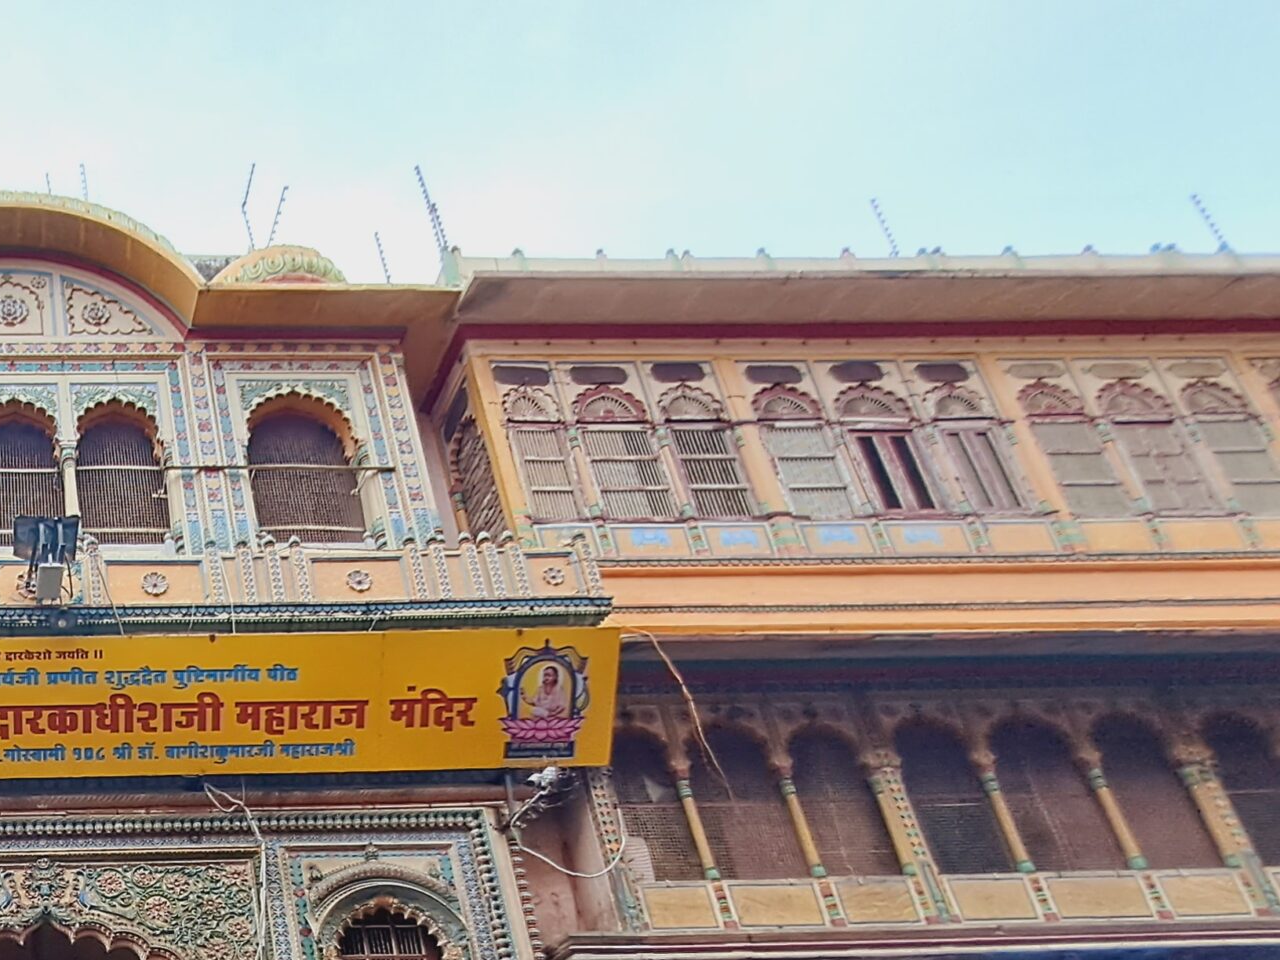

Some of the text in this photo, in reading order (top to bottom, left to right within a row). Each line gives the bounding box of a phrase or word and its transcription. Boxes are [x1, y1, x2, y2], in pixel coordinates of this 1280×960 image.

[55, 648, 89, 660] जयति
[46, 667, 98, 685] प्रणीत
[266, 663, 298, 682] पीठ
[235, 700, 368, 735] महाराज
[390, 685, 477, 732] मंदिर
[112, 742, 132, 760] श्री
[137, 742, 159, 760] डॉ.
